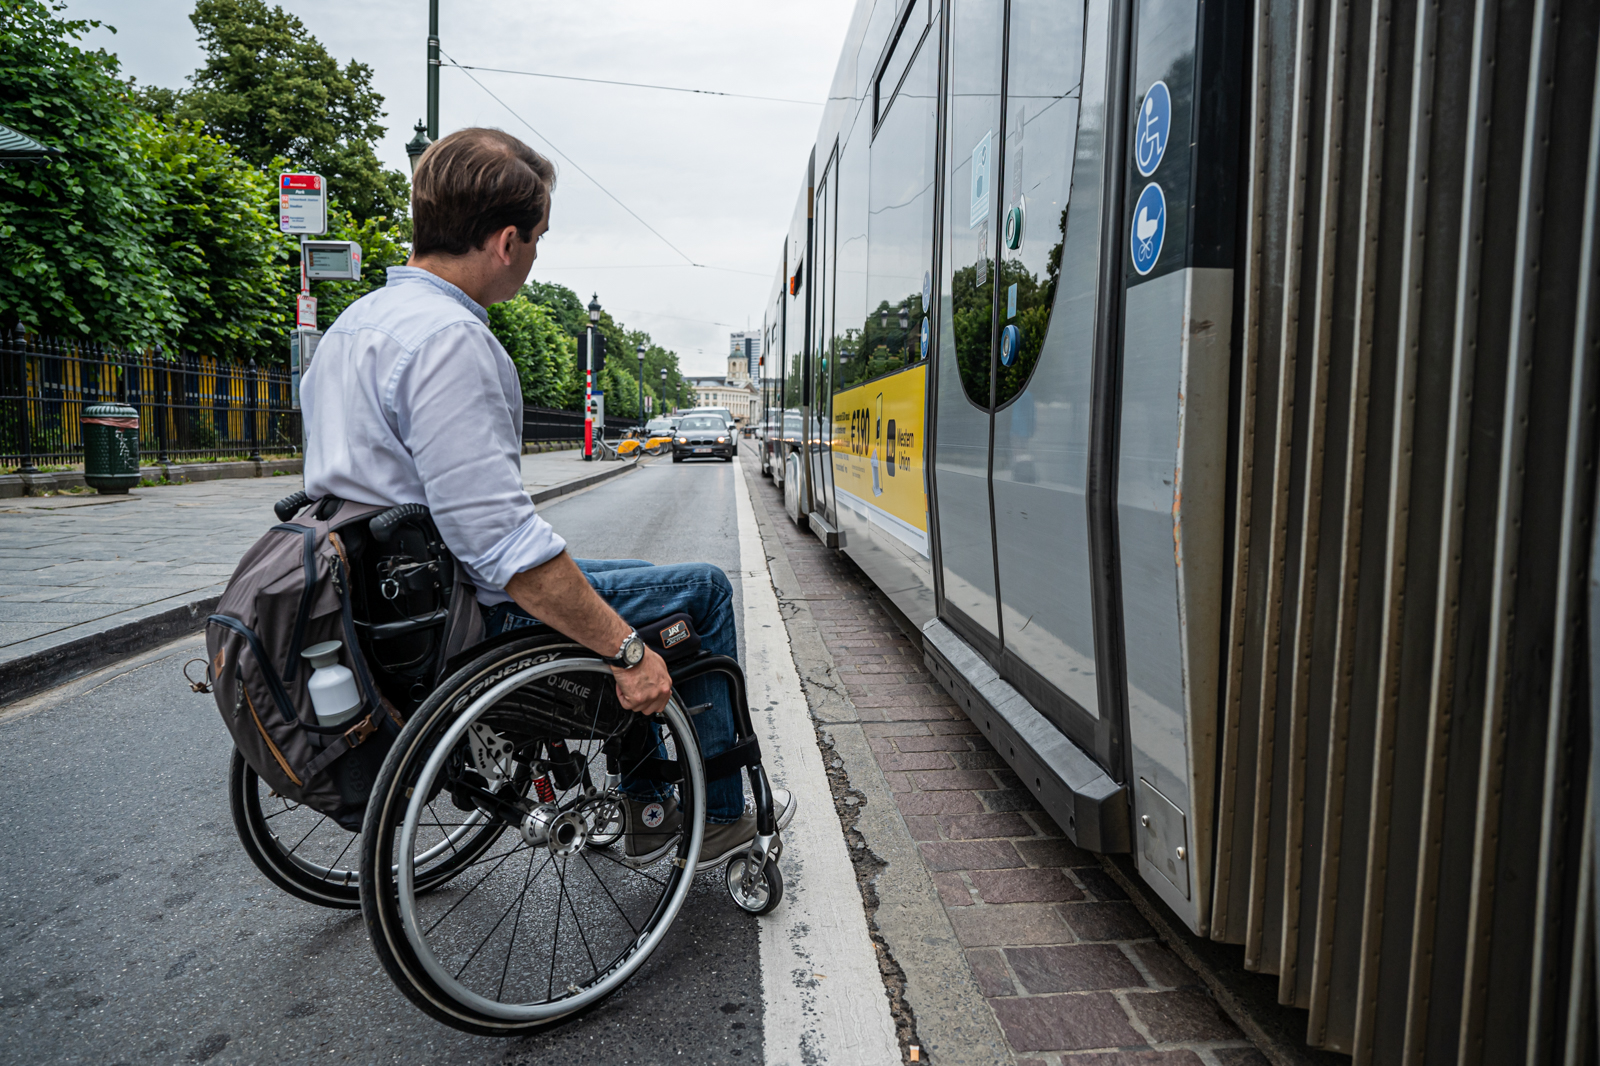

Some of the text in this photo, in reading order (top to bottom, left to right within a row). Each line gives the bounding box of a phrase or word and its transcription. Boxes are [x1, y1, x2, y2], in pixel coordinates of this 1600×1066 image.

[897, 428, 914, 448] Western
[898, 450, 911, 472] Union
[668, 623, 680, 637] JAY
[547, 674, 591, 699] QUICKIE
